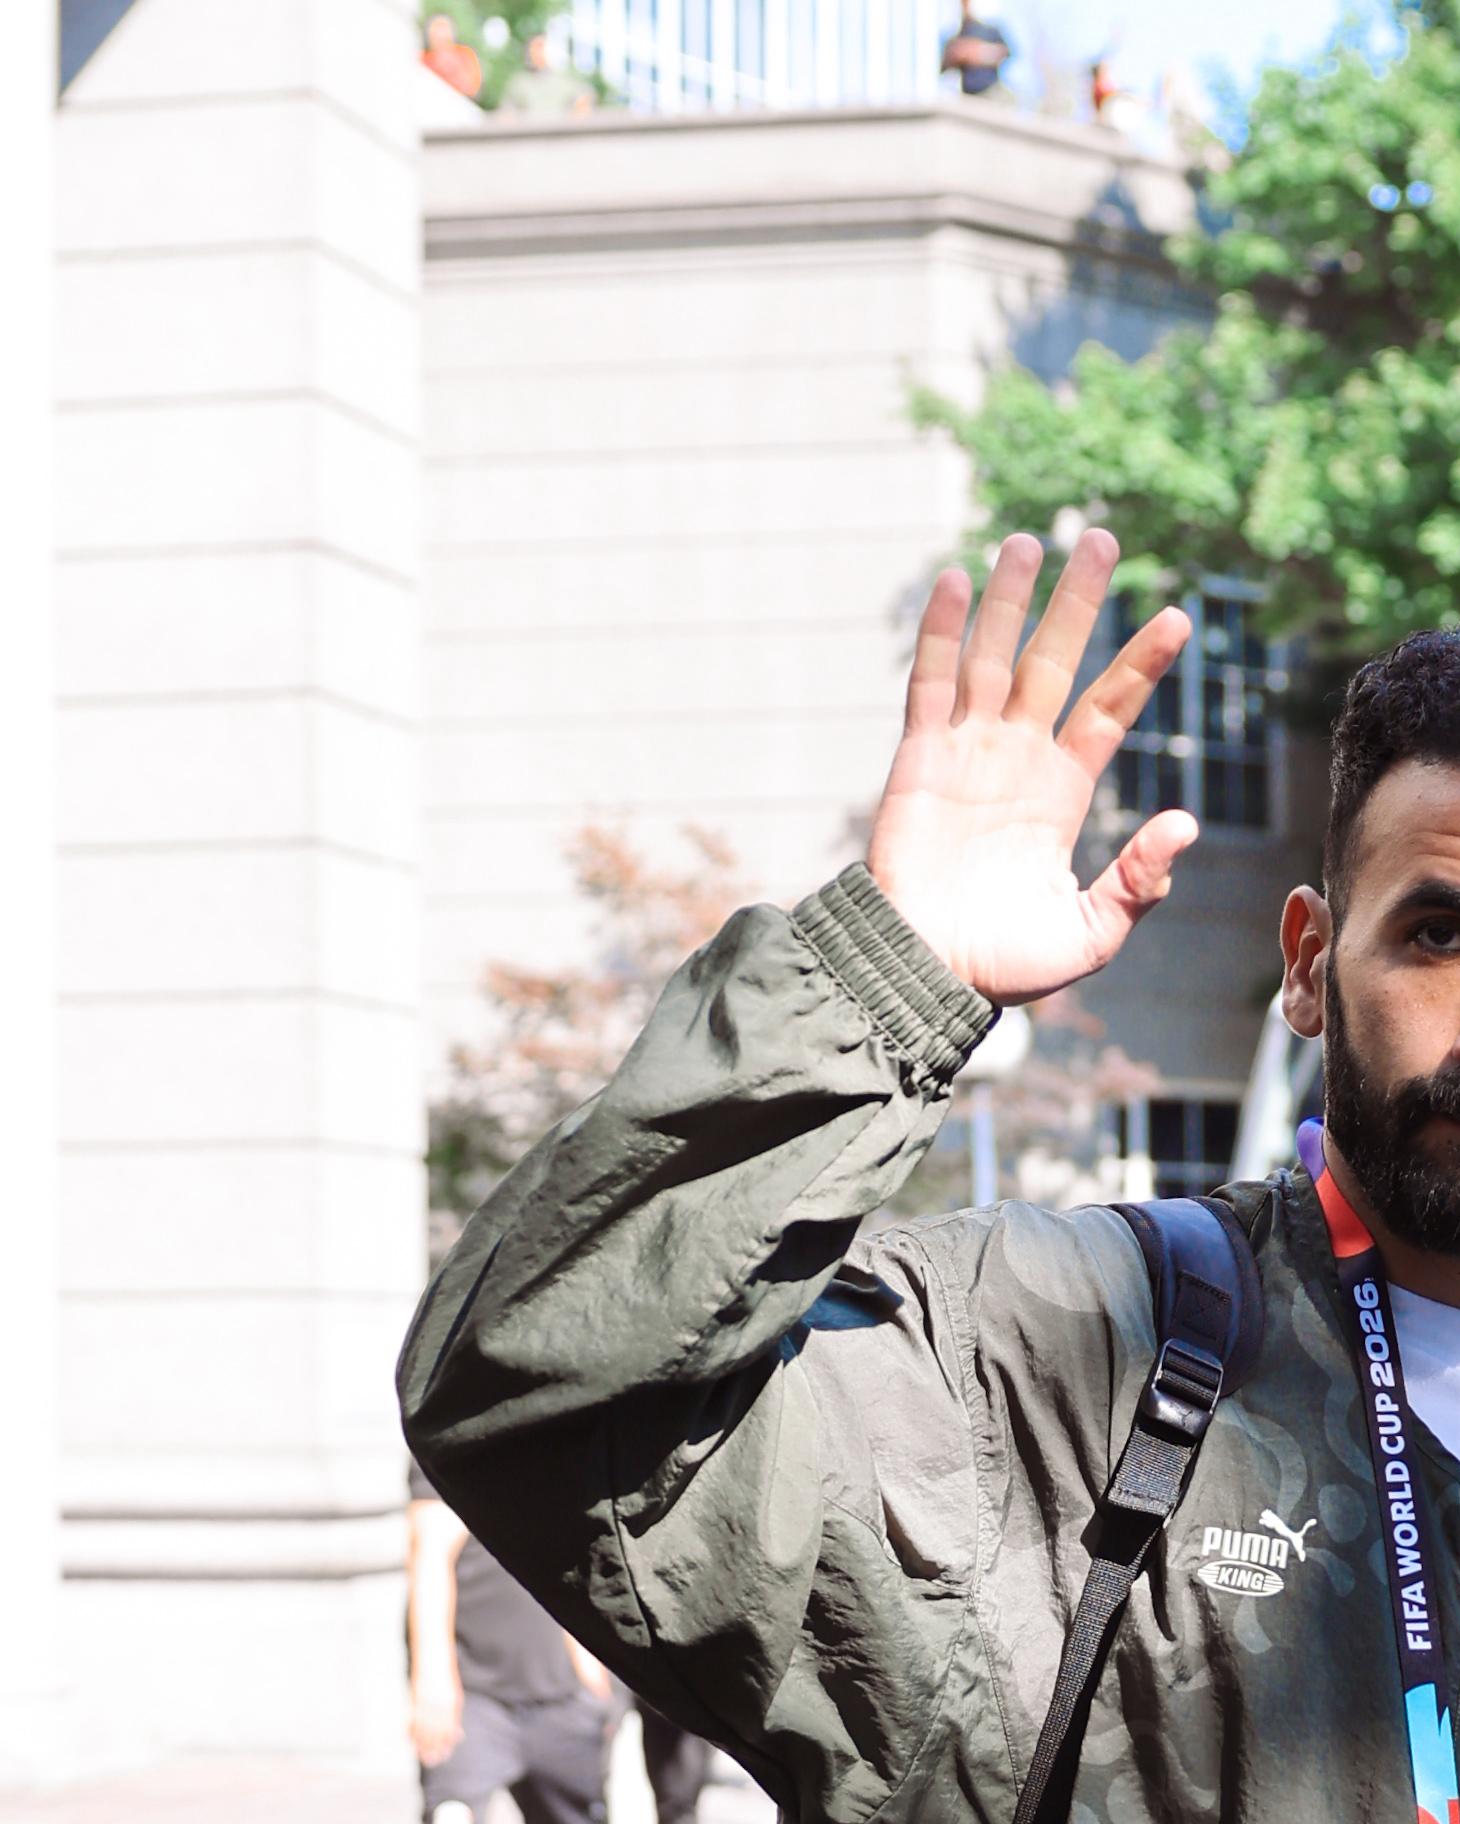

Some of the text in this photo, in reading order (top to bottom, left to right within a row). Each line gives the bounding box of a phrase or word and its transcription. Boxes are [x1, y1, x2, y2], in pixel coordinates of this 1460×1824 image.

[1375, 1392, 1406, 1456] CUP
[1202, 1526, 1289, 1569] PUMA
[1385, 1460, 1423, 1577] WORLD
[1218, 1566, 1266, 1593] KING
[1401, 1581, 1432, 1650] FIFA
